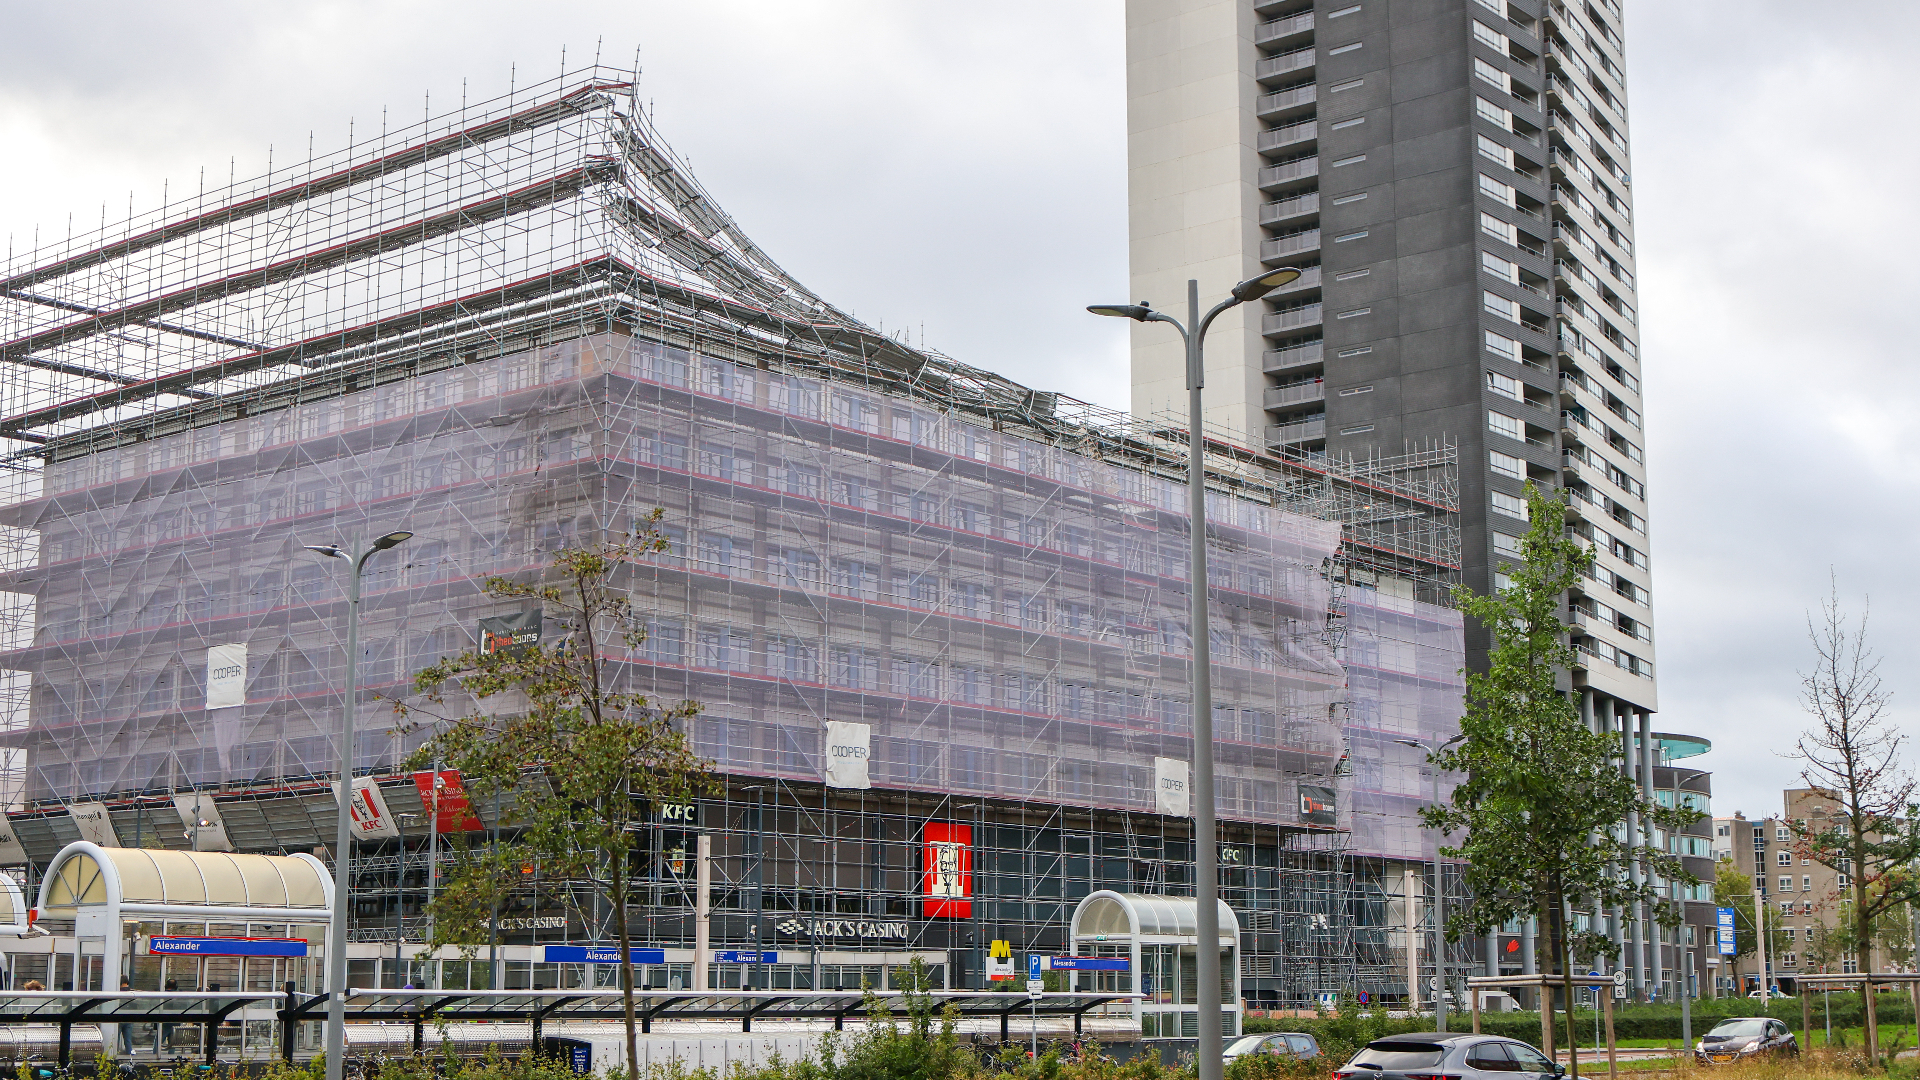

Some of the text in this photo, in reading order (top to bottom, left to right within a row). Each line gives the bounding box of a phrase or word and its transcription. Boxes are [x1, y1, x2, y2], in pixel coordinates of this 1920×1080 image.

[213, 665, 241, 680] COOPER
[831, 745, 867, 758] COOPER
[1161, 777, 1184, 791] COOPER
[662, 803, 695, 820] KFC
[361, 819, 382, 831] KFC
[526, 916, 565, 929] CASINO
[804, 920, 909, 938] JACK'S CASINO
[154, 941, 201, 951] Alexander
[586, 951, 624, 961] Alexande
[1032, 957, 1039, 970] P
[1053, 959, 1076, 967] Alexander
